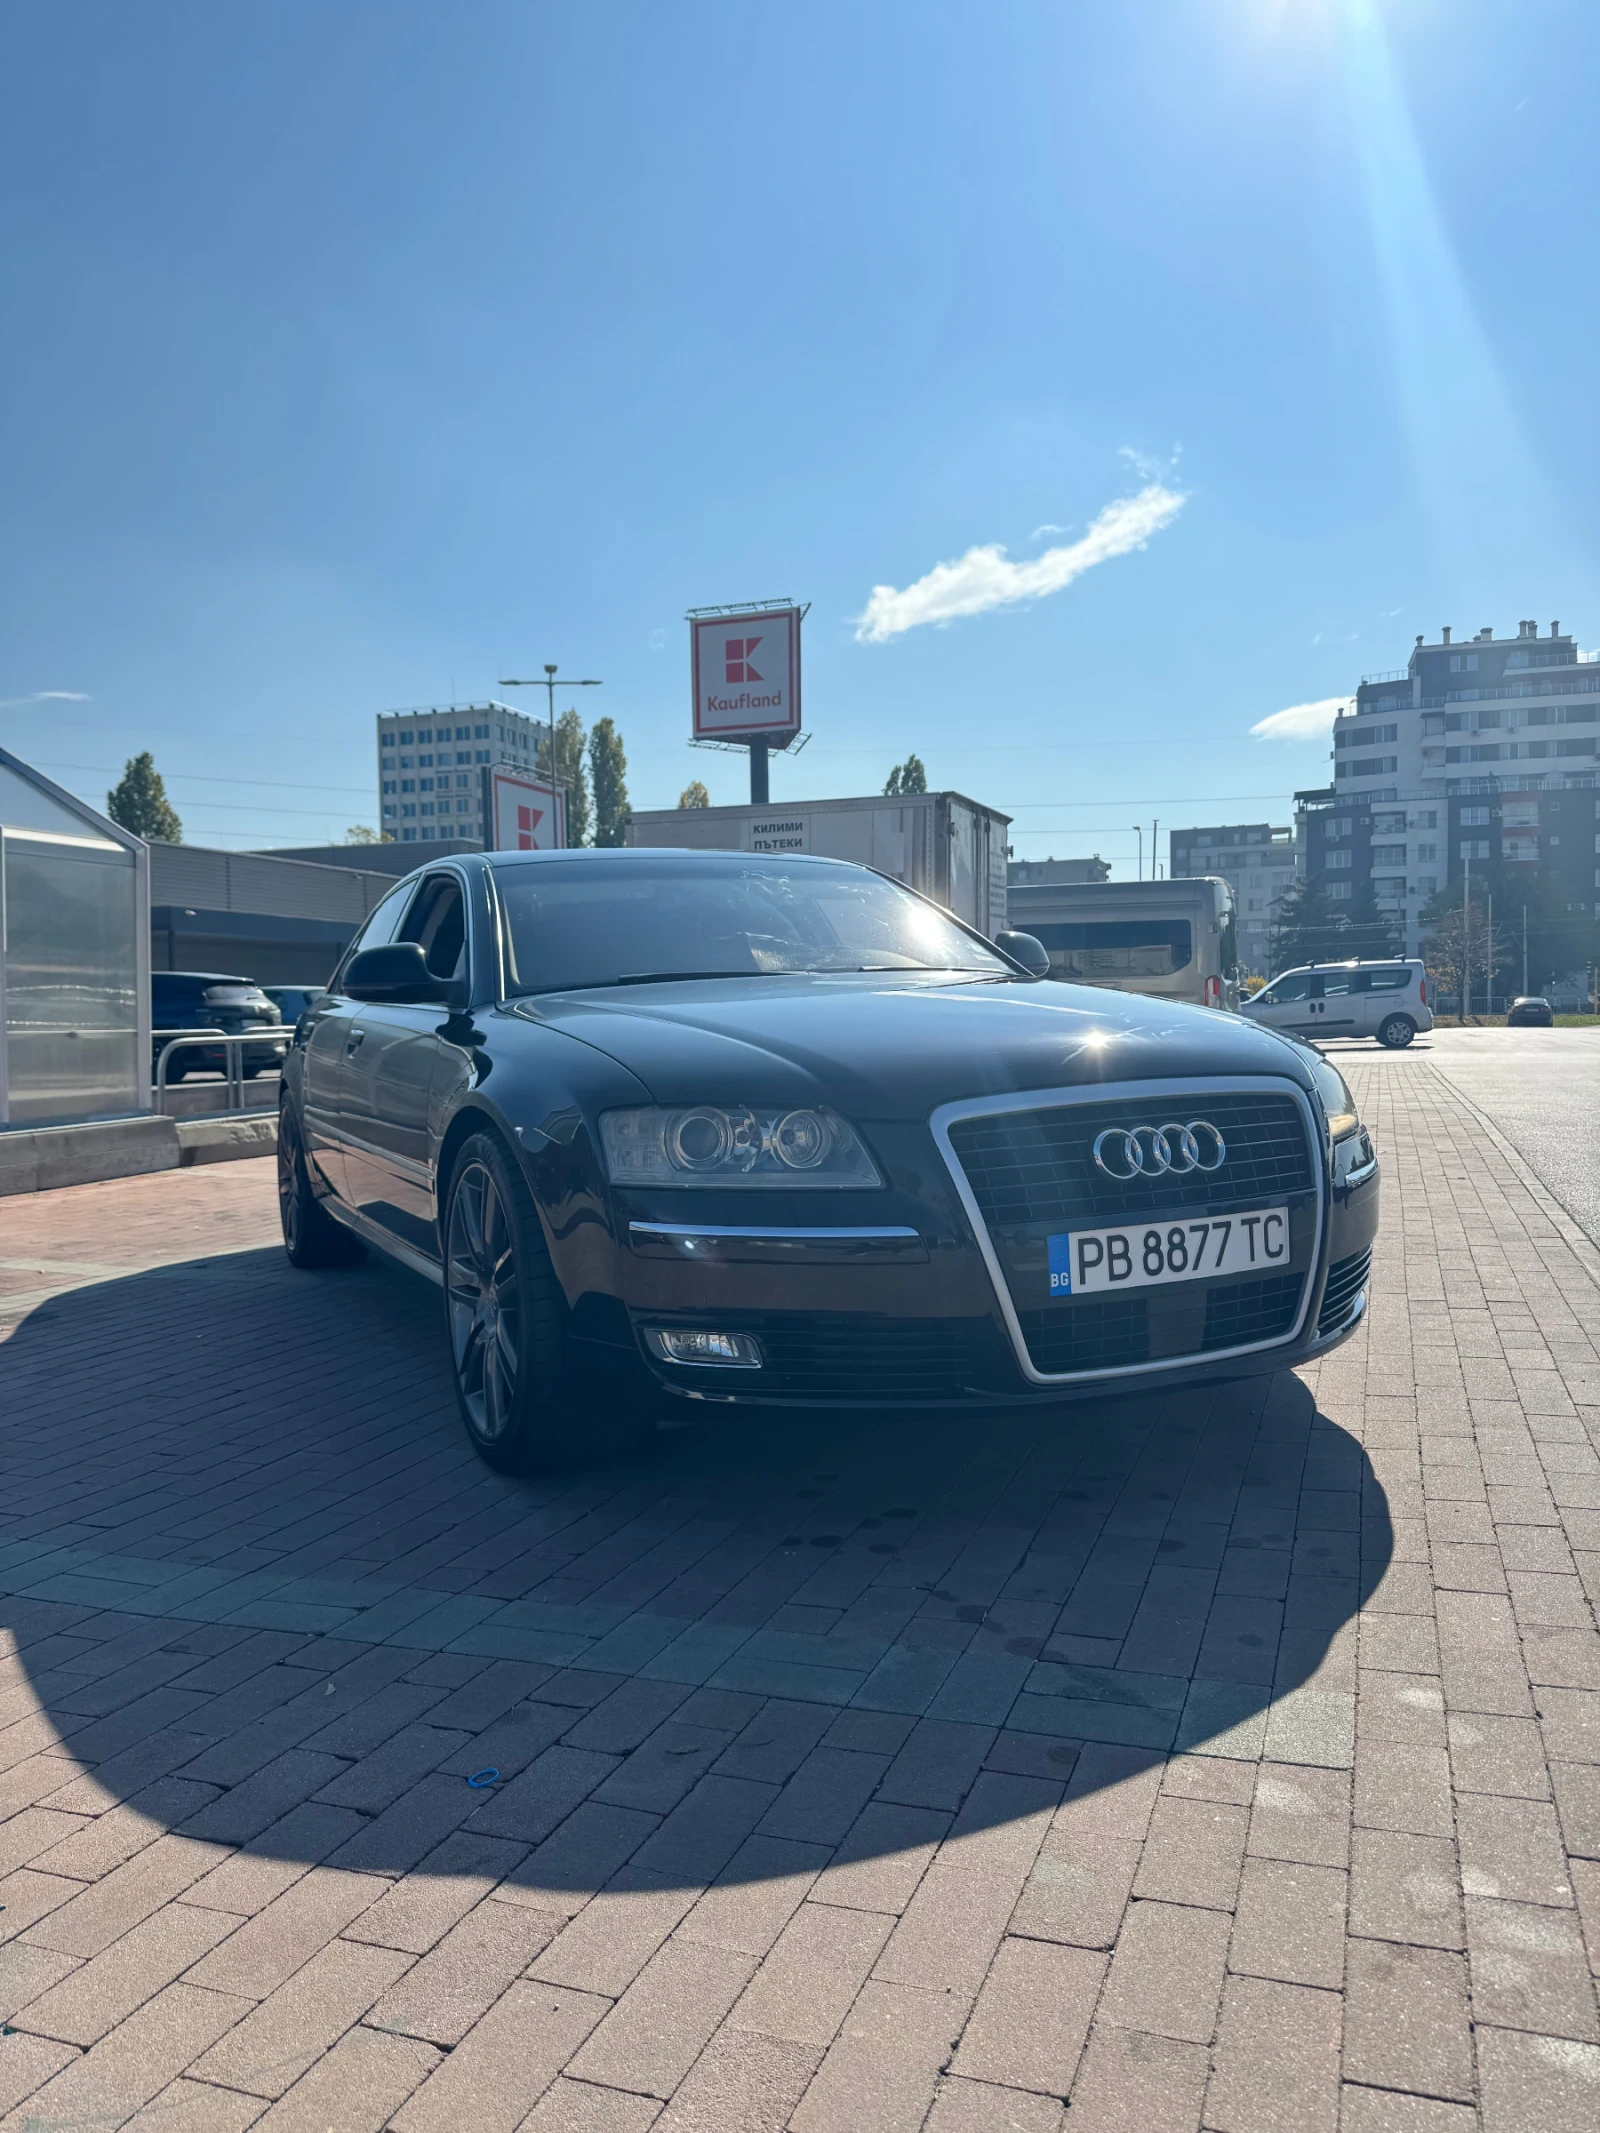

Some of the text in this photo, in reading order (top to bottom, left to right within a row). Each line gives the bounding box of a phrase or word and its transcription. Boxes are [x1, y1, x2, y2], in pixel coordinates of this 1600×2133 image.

[707, 690, 782, 712] Kaufland
[753, 822, 803, 834] КИЛИМИ
[754, 838, 803, 850] ПЪТЕКИ
[1077, 1214, 1284, 1285] PB 8877 TC
[1050, 1272, 1069, 1288] BG
